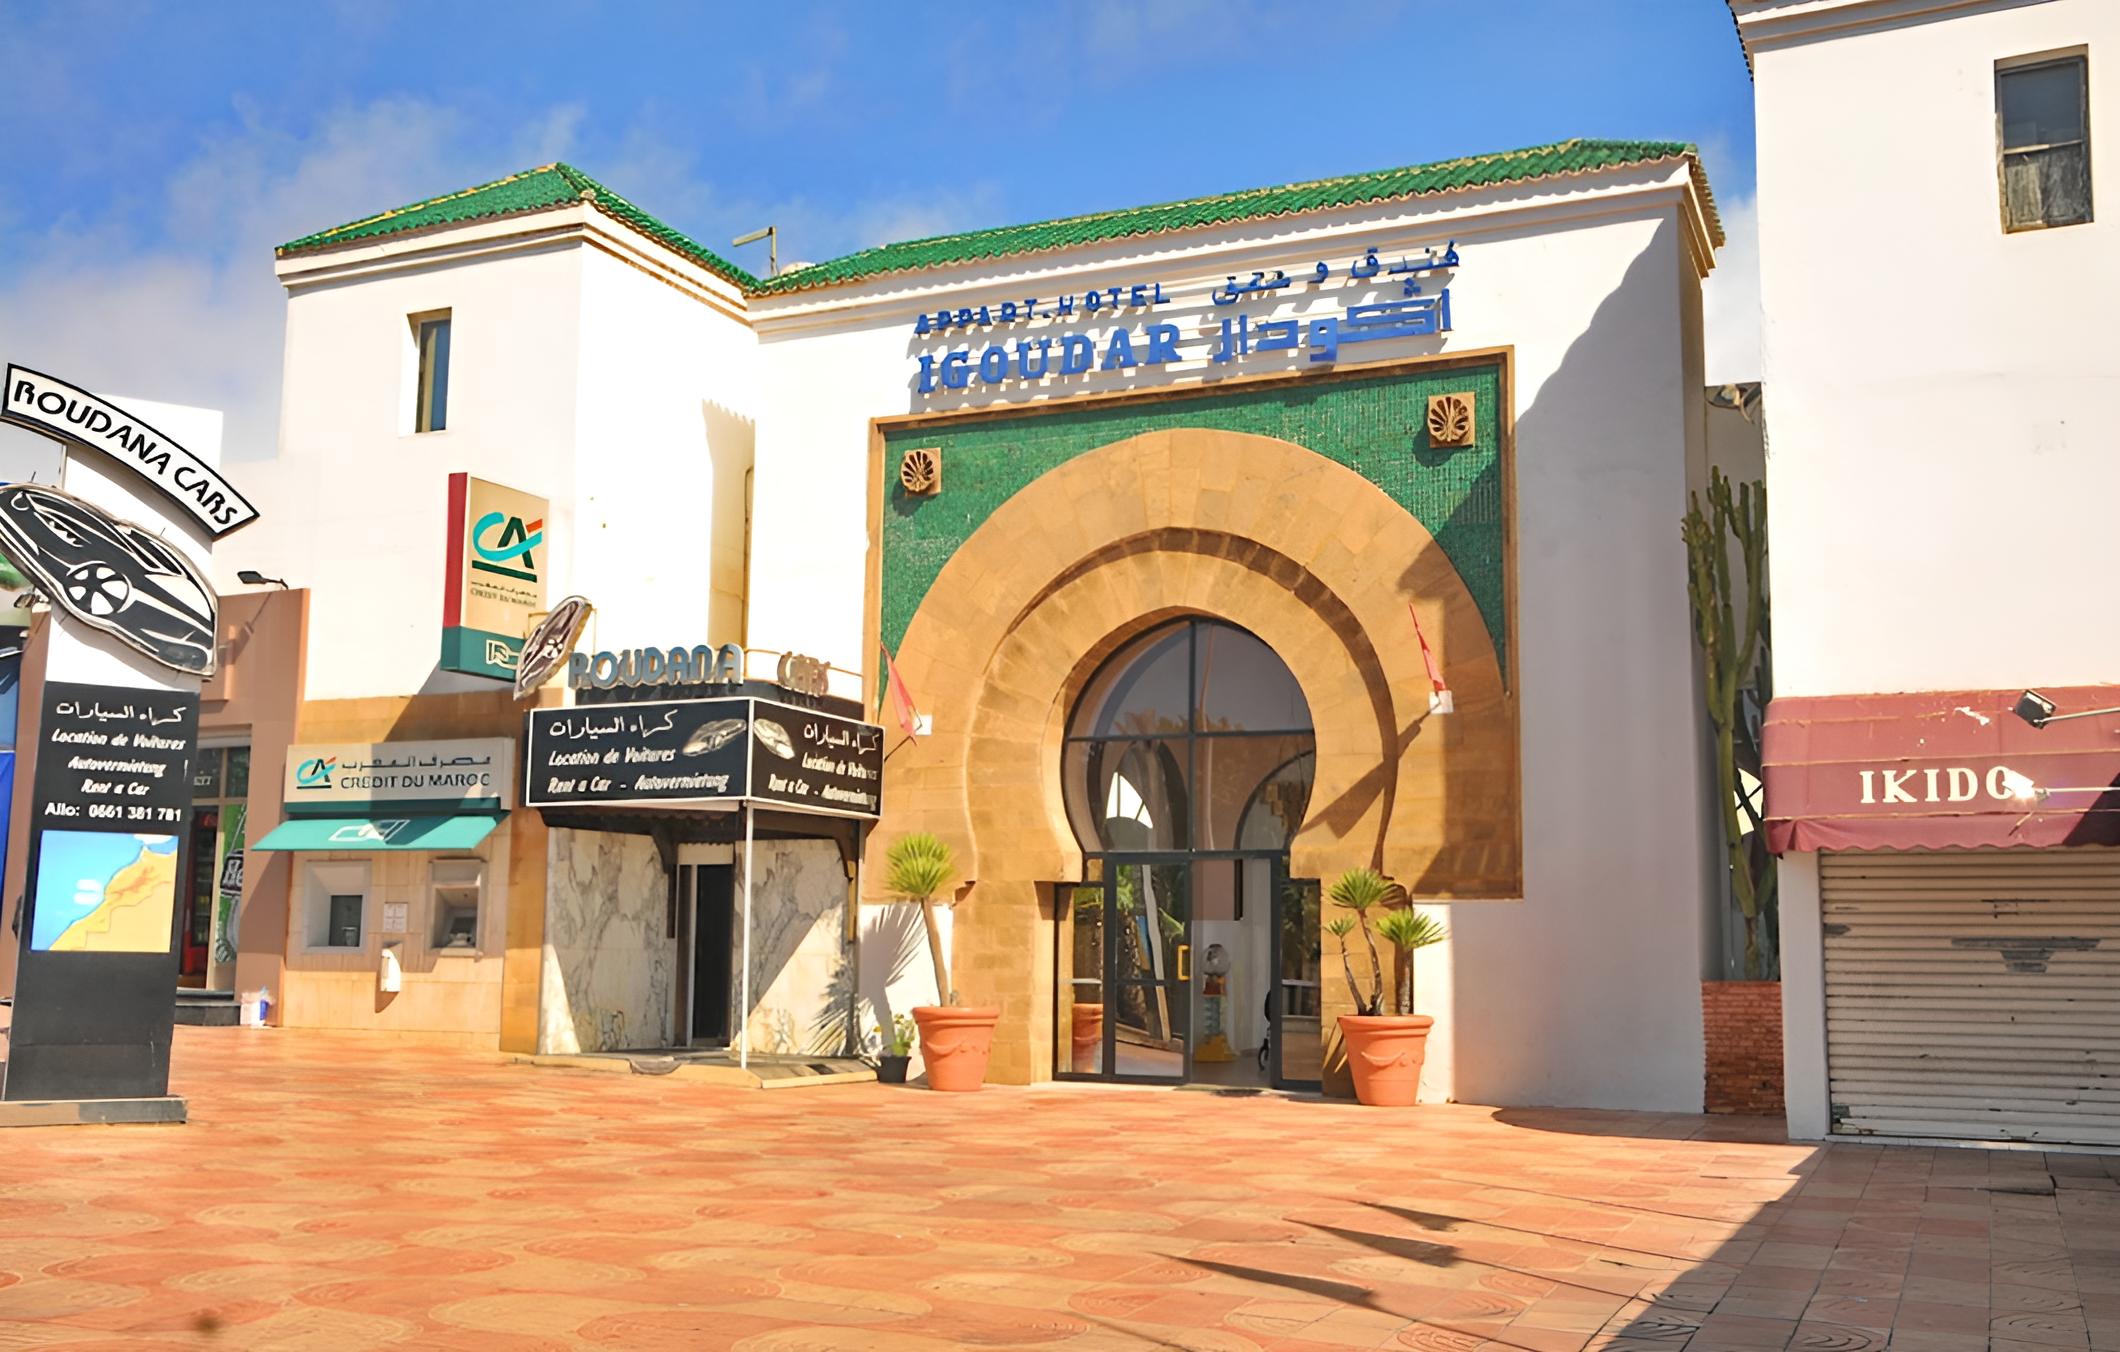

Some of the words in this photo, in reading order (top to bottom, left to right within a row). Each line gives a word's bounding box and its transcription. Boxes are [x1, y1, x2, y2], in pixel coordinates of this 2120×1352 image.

[918, 323, 1182, 394] IGOUDAR
[14, 380, 171, 475] ROUDANA
[173, 466, 238, 526] CARS
[568, 643, 744, 690] ROUDANA
[51, 728, 108, 746] Location
[111, 733, 129, 747] de
[133, 733, 187, 750] Voitures
[549, 749, 600, 766] Location
[602, 748, 620, 764] de
[624, 746, 676, 763] Voitures
[81, 778, 112, 794] Rent
[114, 783, 125, 795] a
[127, 781, 150, 796] Car
[341, 776, 399, 790] CREDIT
[402, 775, 424, 789] DU
[428, 773, 491, 787] MAROC
[548, 776, 576, 793] Rent
[578, 779, 588, 792] a
[591, 775, 612, 792] Car
[45, 802, 81, 817] Allo:
[127, 806, 152, 820] 381
[157, 807, 182, 822] 781
